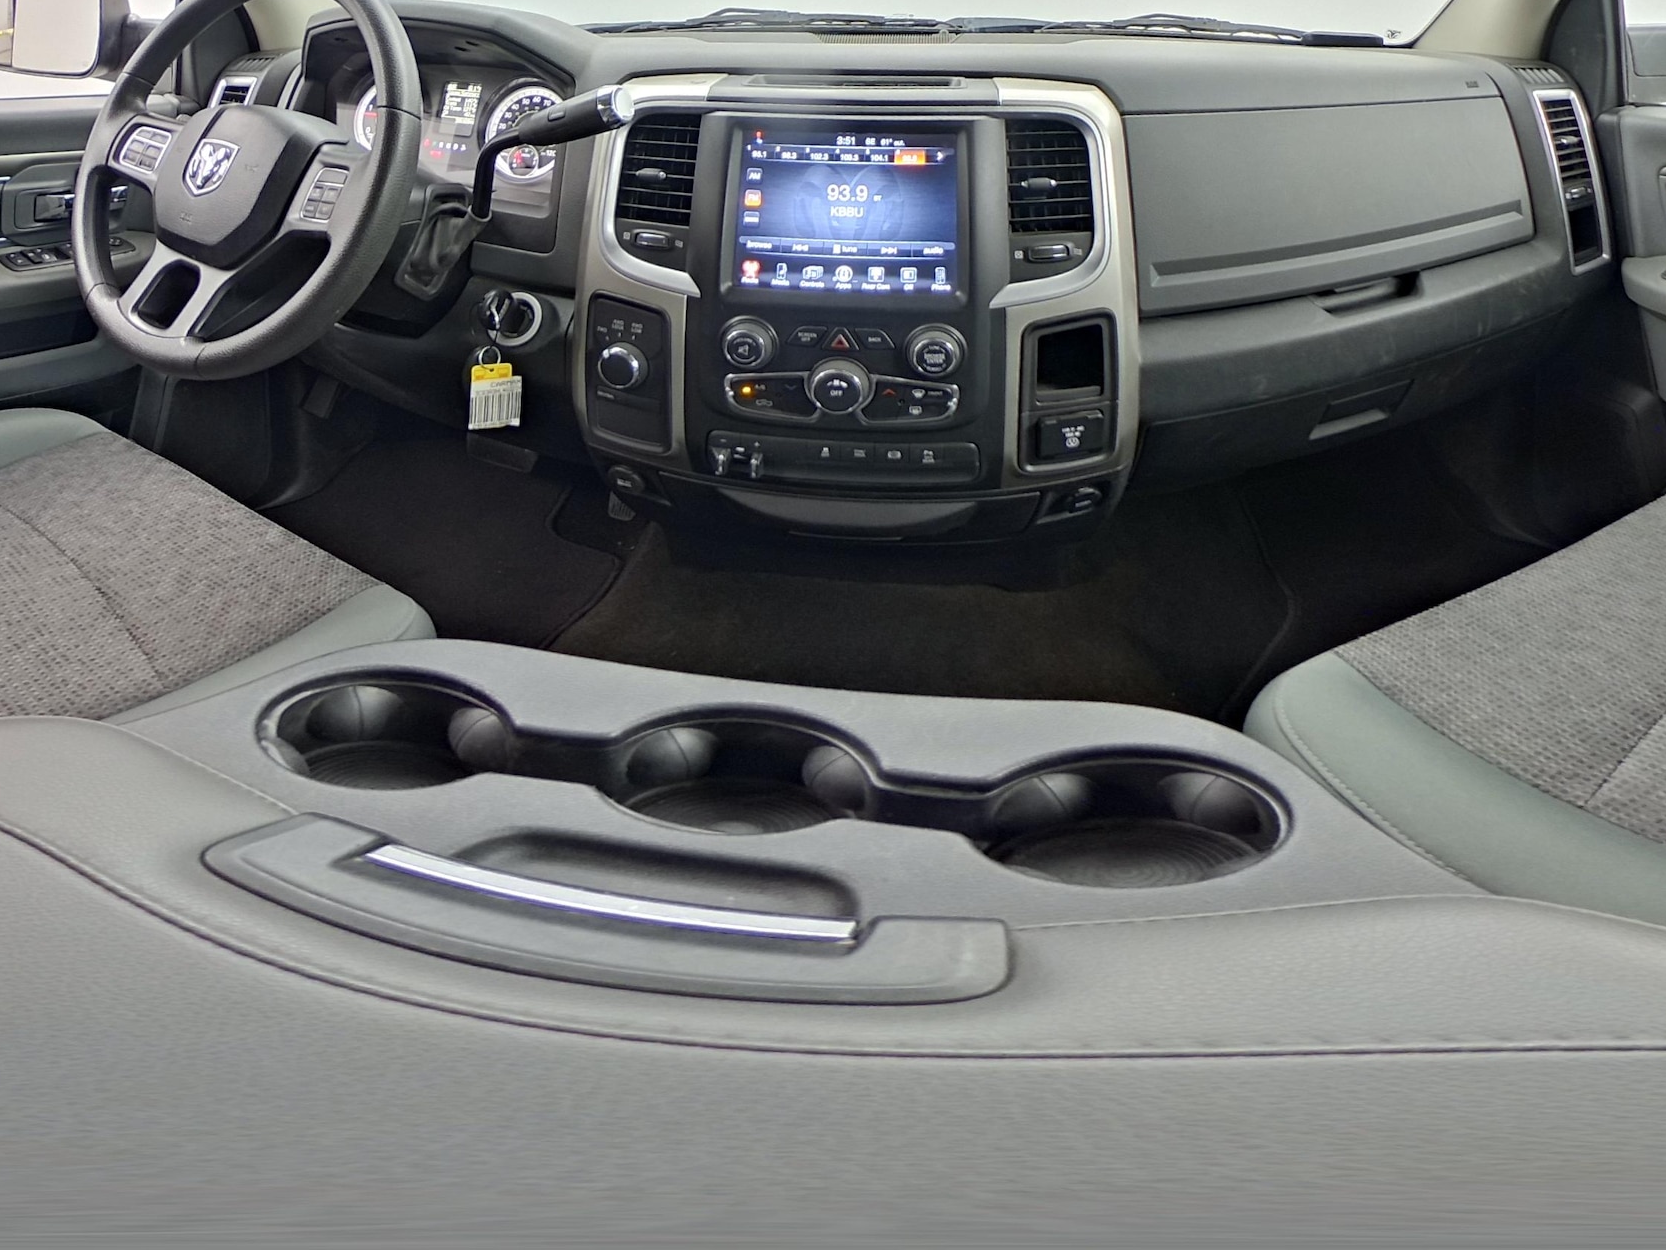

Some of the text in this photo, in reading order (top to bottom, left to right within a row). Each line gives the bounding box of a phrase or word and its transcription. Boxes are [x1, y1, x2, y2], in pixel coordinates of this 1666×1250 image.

[511, 103, 520, 111] 40
[836, 136, 856, 146] 3:51
[748, 172, 761, 181] AM
[748, 193, 759, 202] FM
[827, 184, 868, 203] 93.9
[830, 206, 864, 218] KBBU
[842, 245, 858, 253] tune
[922, 246, 944, 255] audio
[830, 389, 844, 397] OFF
